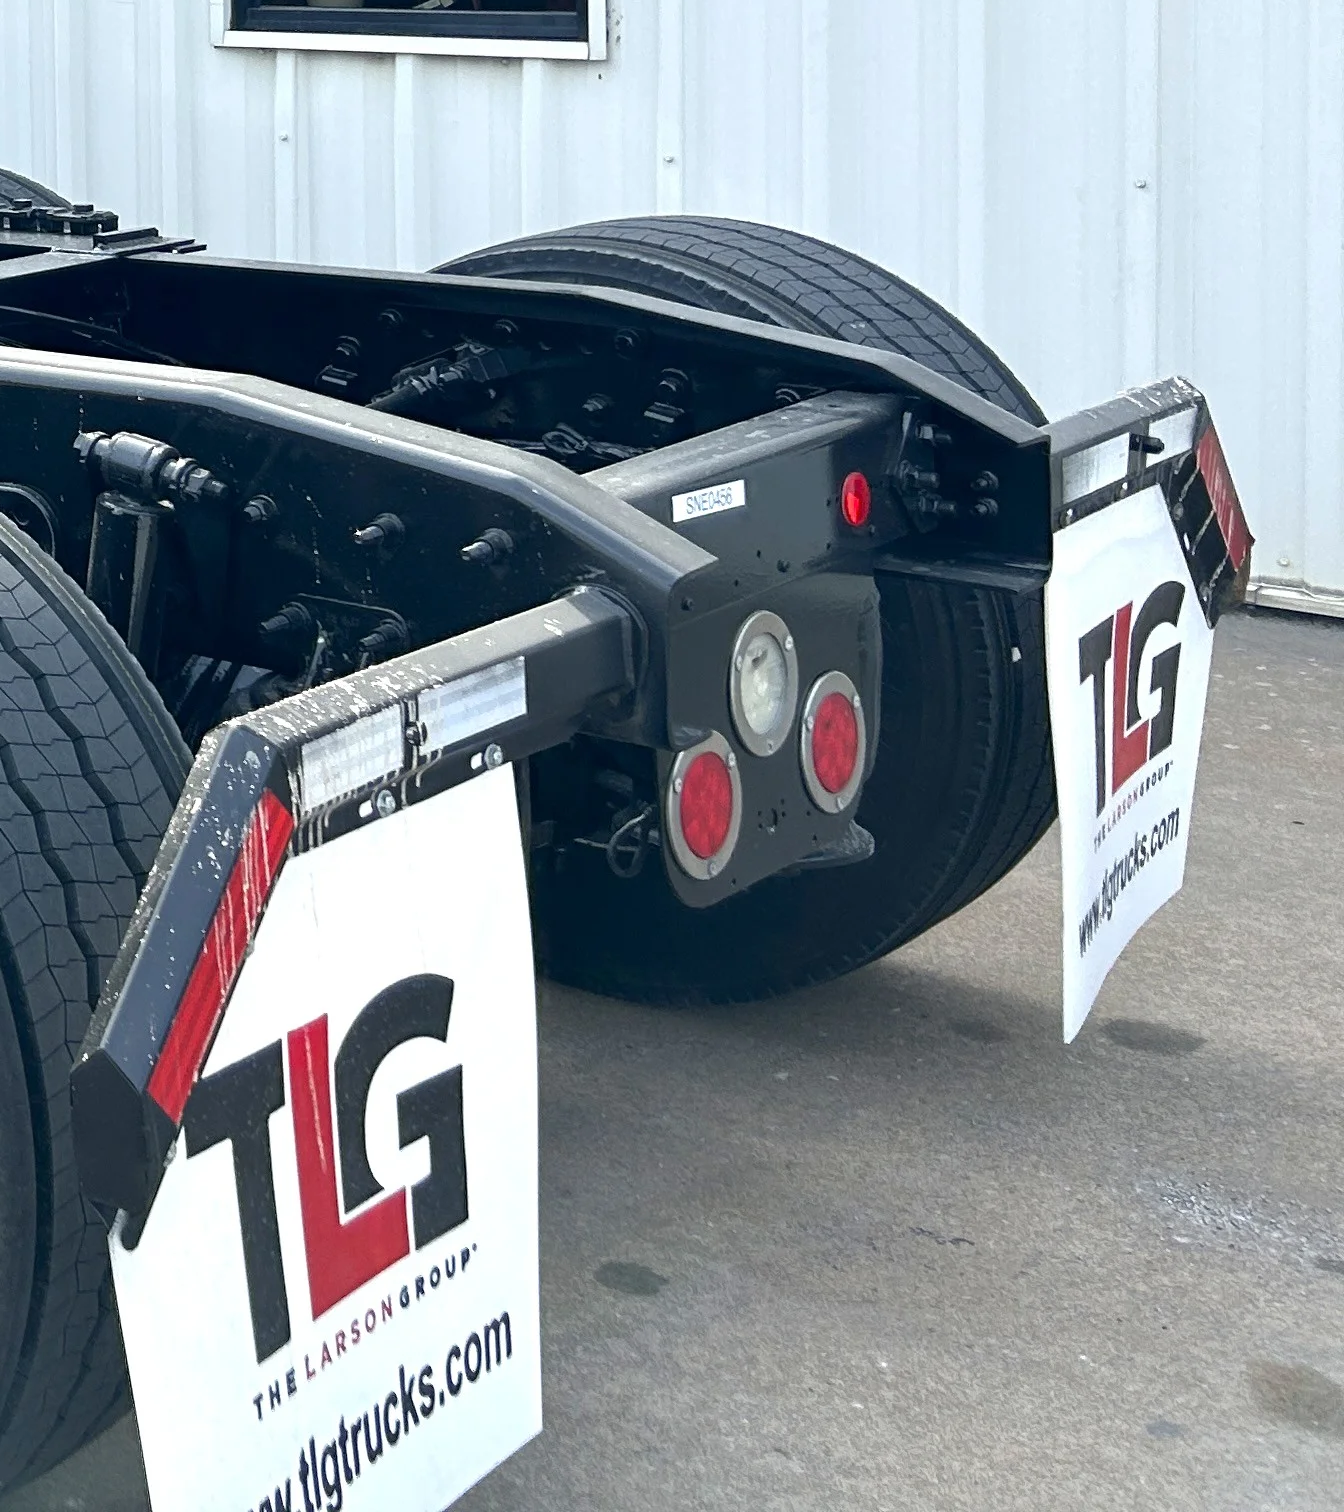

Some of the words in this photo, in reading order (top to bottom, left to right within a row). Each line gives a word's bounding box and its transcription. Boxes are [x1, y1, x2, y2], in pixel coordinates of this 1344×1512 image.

[685, 486, 733, 515] SNE0456
[1079, 580, 1186, 819] TLG
[1079, 807, 1180, 958] www.tlgtrucks.com
[1093, 824, 1107, 854] THE
[1107, 788, 1138, 834] LARSON
[1139, 762, 1171, 797] GROUP
[179, 973, 470, 1365] TLG
[248, 1310, 513, 1512] tlgtrucks.com
[252, 1366, 299, 1421] THE
[304, 1296, 393, 1380] LARSON
[399, 1247, 472, 1309] GROUP
